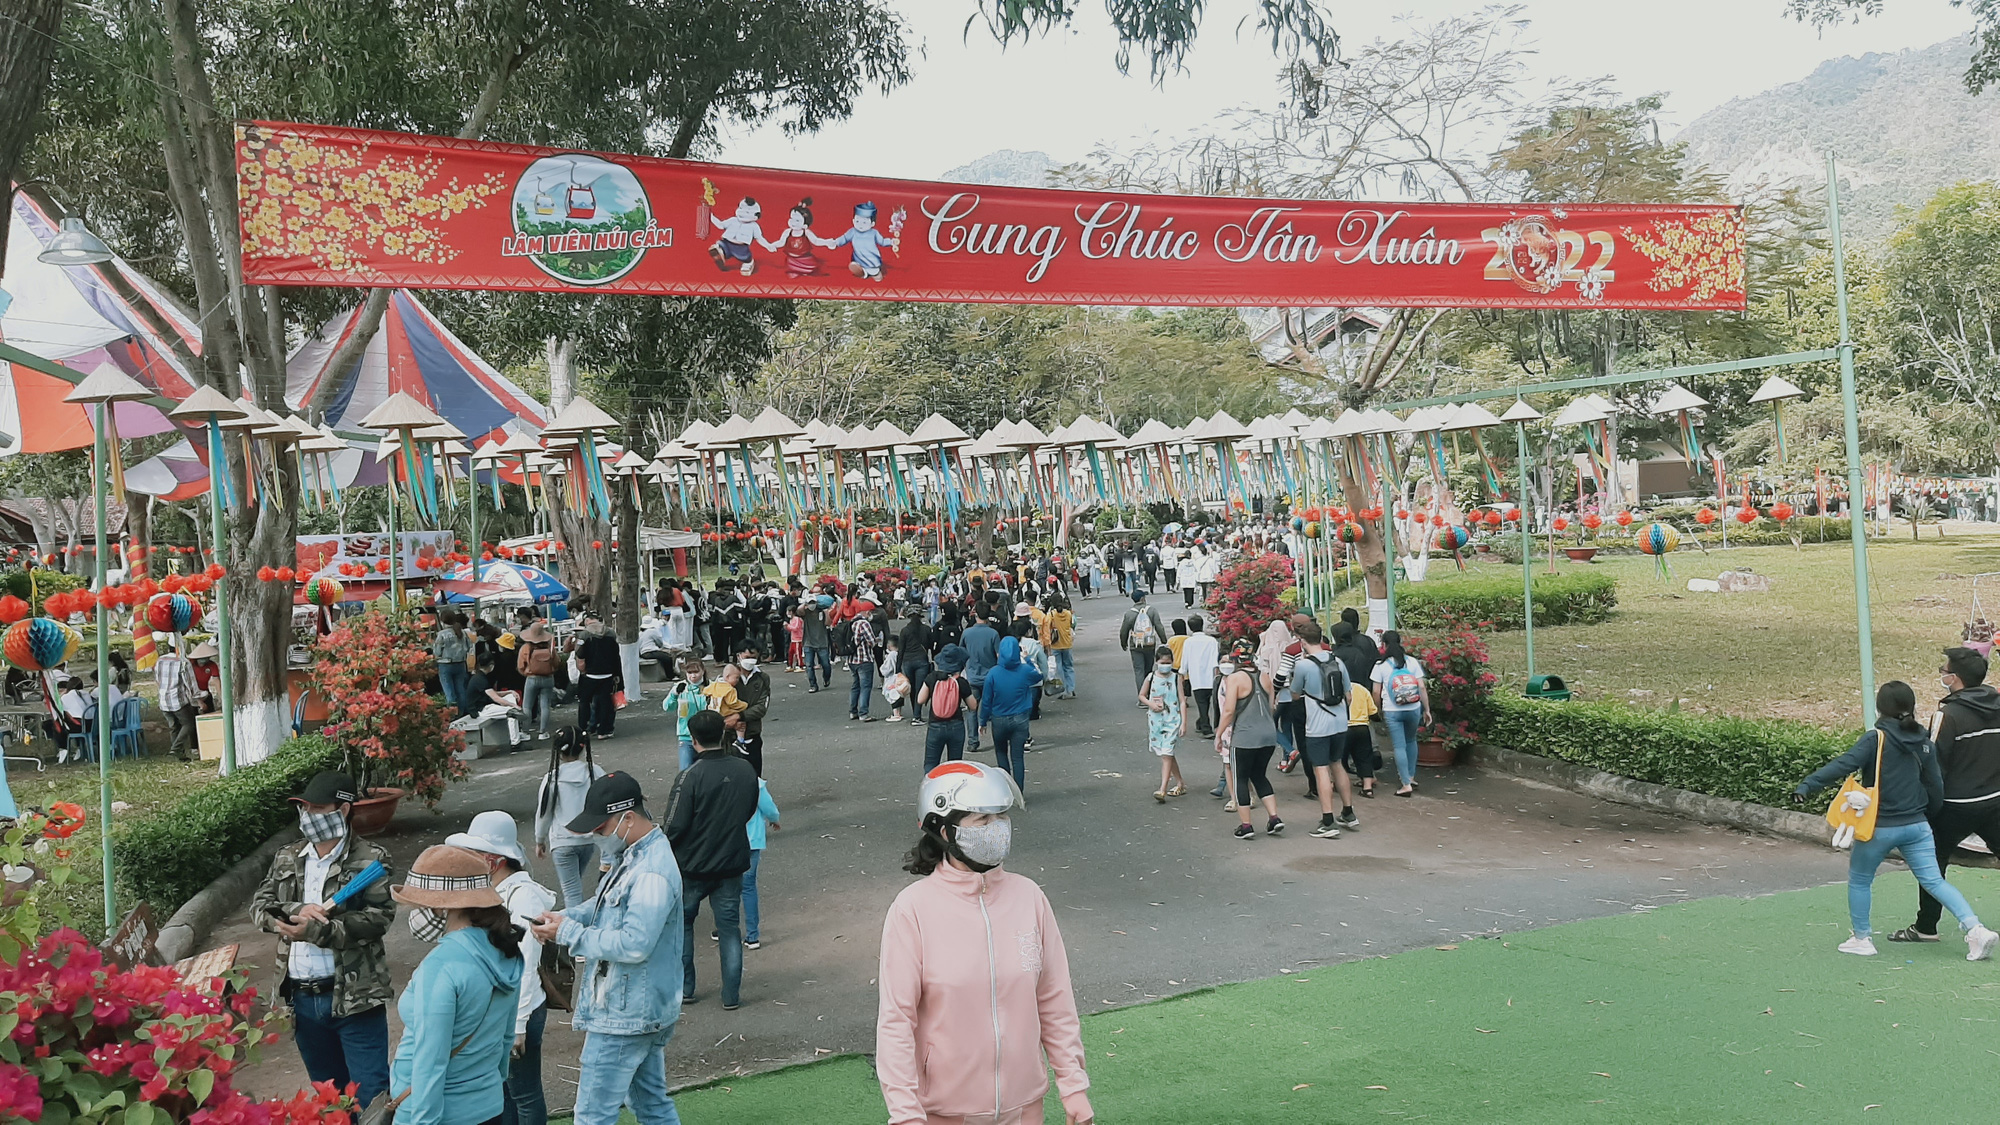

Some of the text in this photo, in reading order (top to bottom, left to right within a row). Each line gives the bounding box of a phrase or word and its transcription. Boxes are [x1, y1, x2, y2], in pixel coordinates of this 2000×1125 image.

[502, 218, 673, 256] LÂM VIÊN NÚI CẤM
[920, 191, 1069, 283] Cung
[1074, 200, 1200, 261] Chúc
[1213, 206, 1322, 264] Tân
[1334, 209, 1466, 267] Xuân
